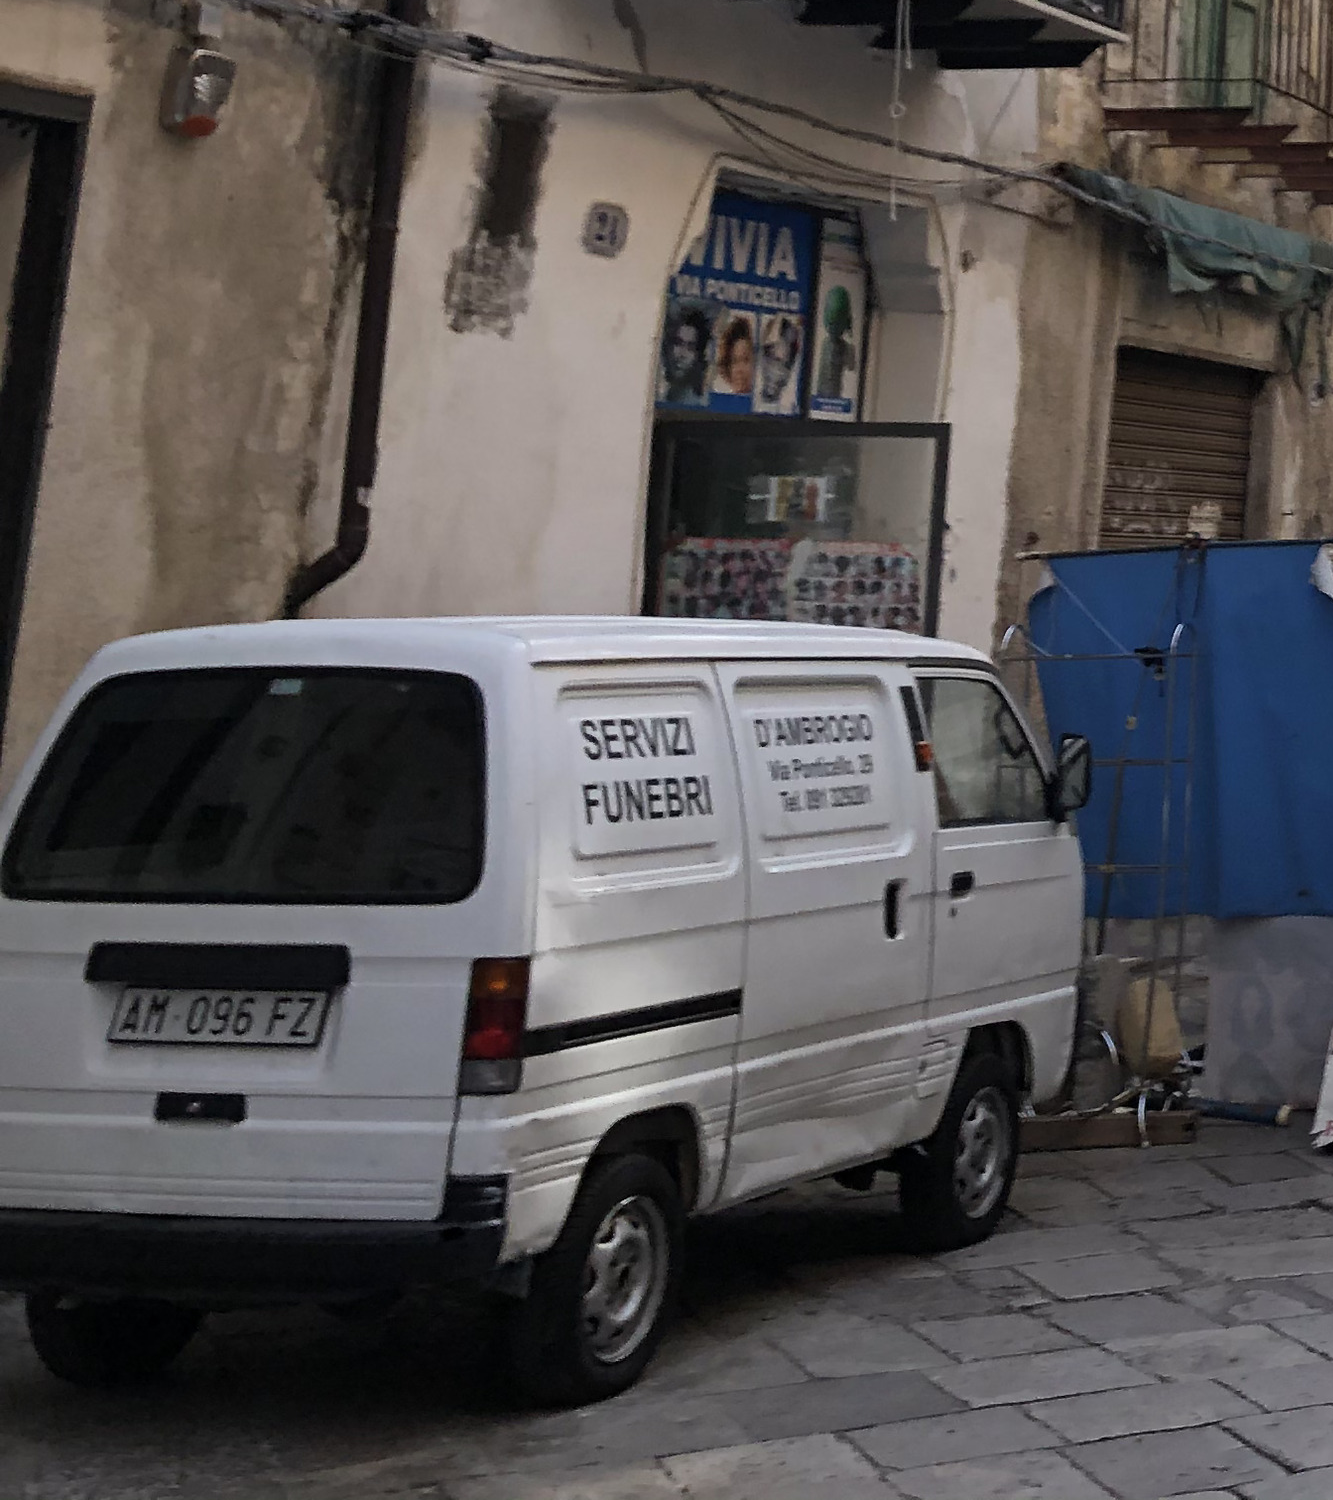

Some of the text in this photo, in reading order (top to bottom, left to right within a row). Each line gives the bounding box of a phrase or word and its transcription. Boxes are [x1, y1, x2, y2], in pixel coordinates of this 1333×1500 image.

[579, 716, 696, 761] SERVIZI
[752, 713, 874, 748] D'AMBROGIO
[581, 774, 715, 826] FUNEBRI
[118, 994, 318, 1037] AM 096 FZ
